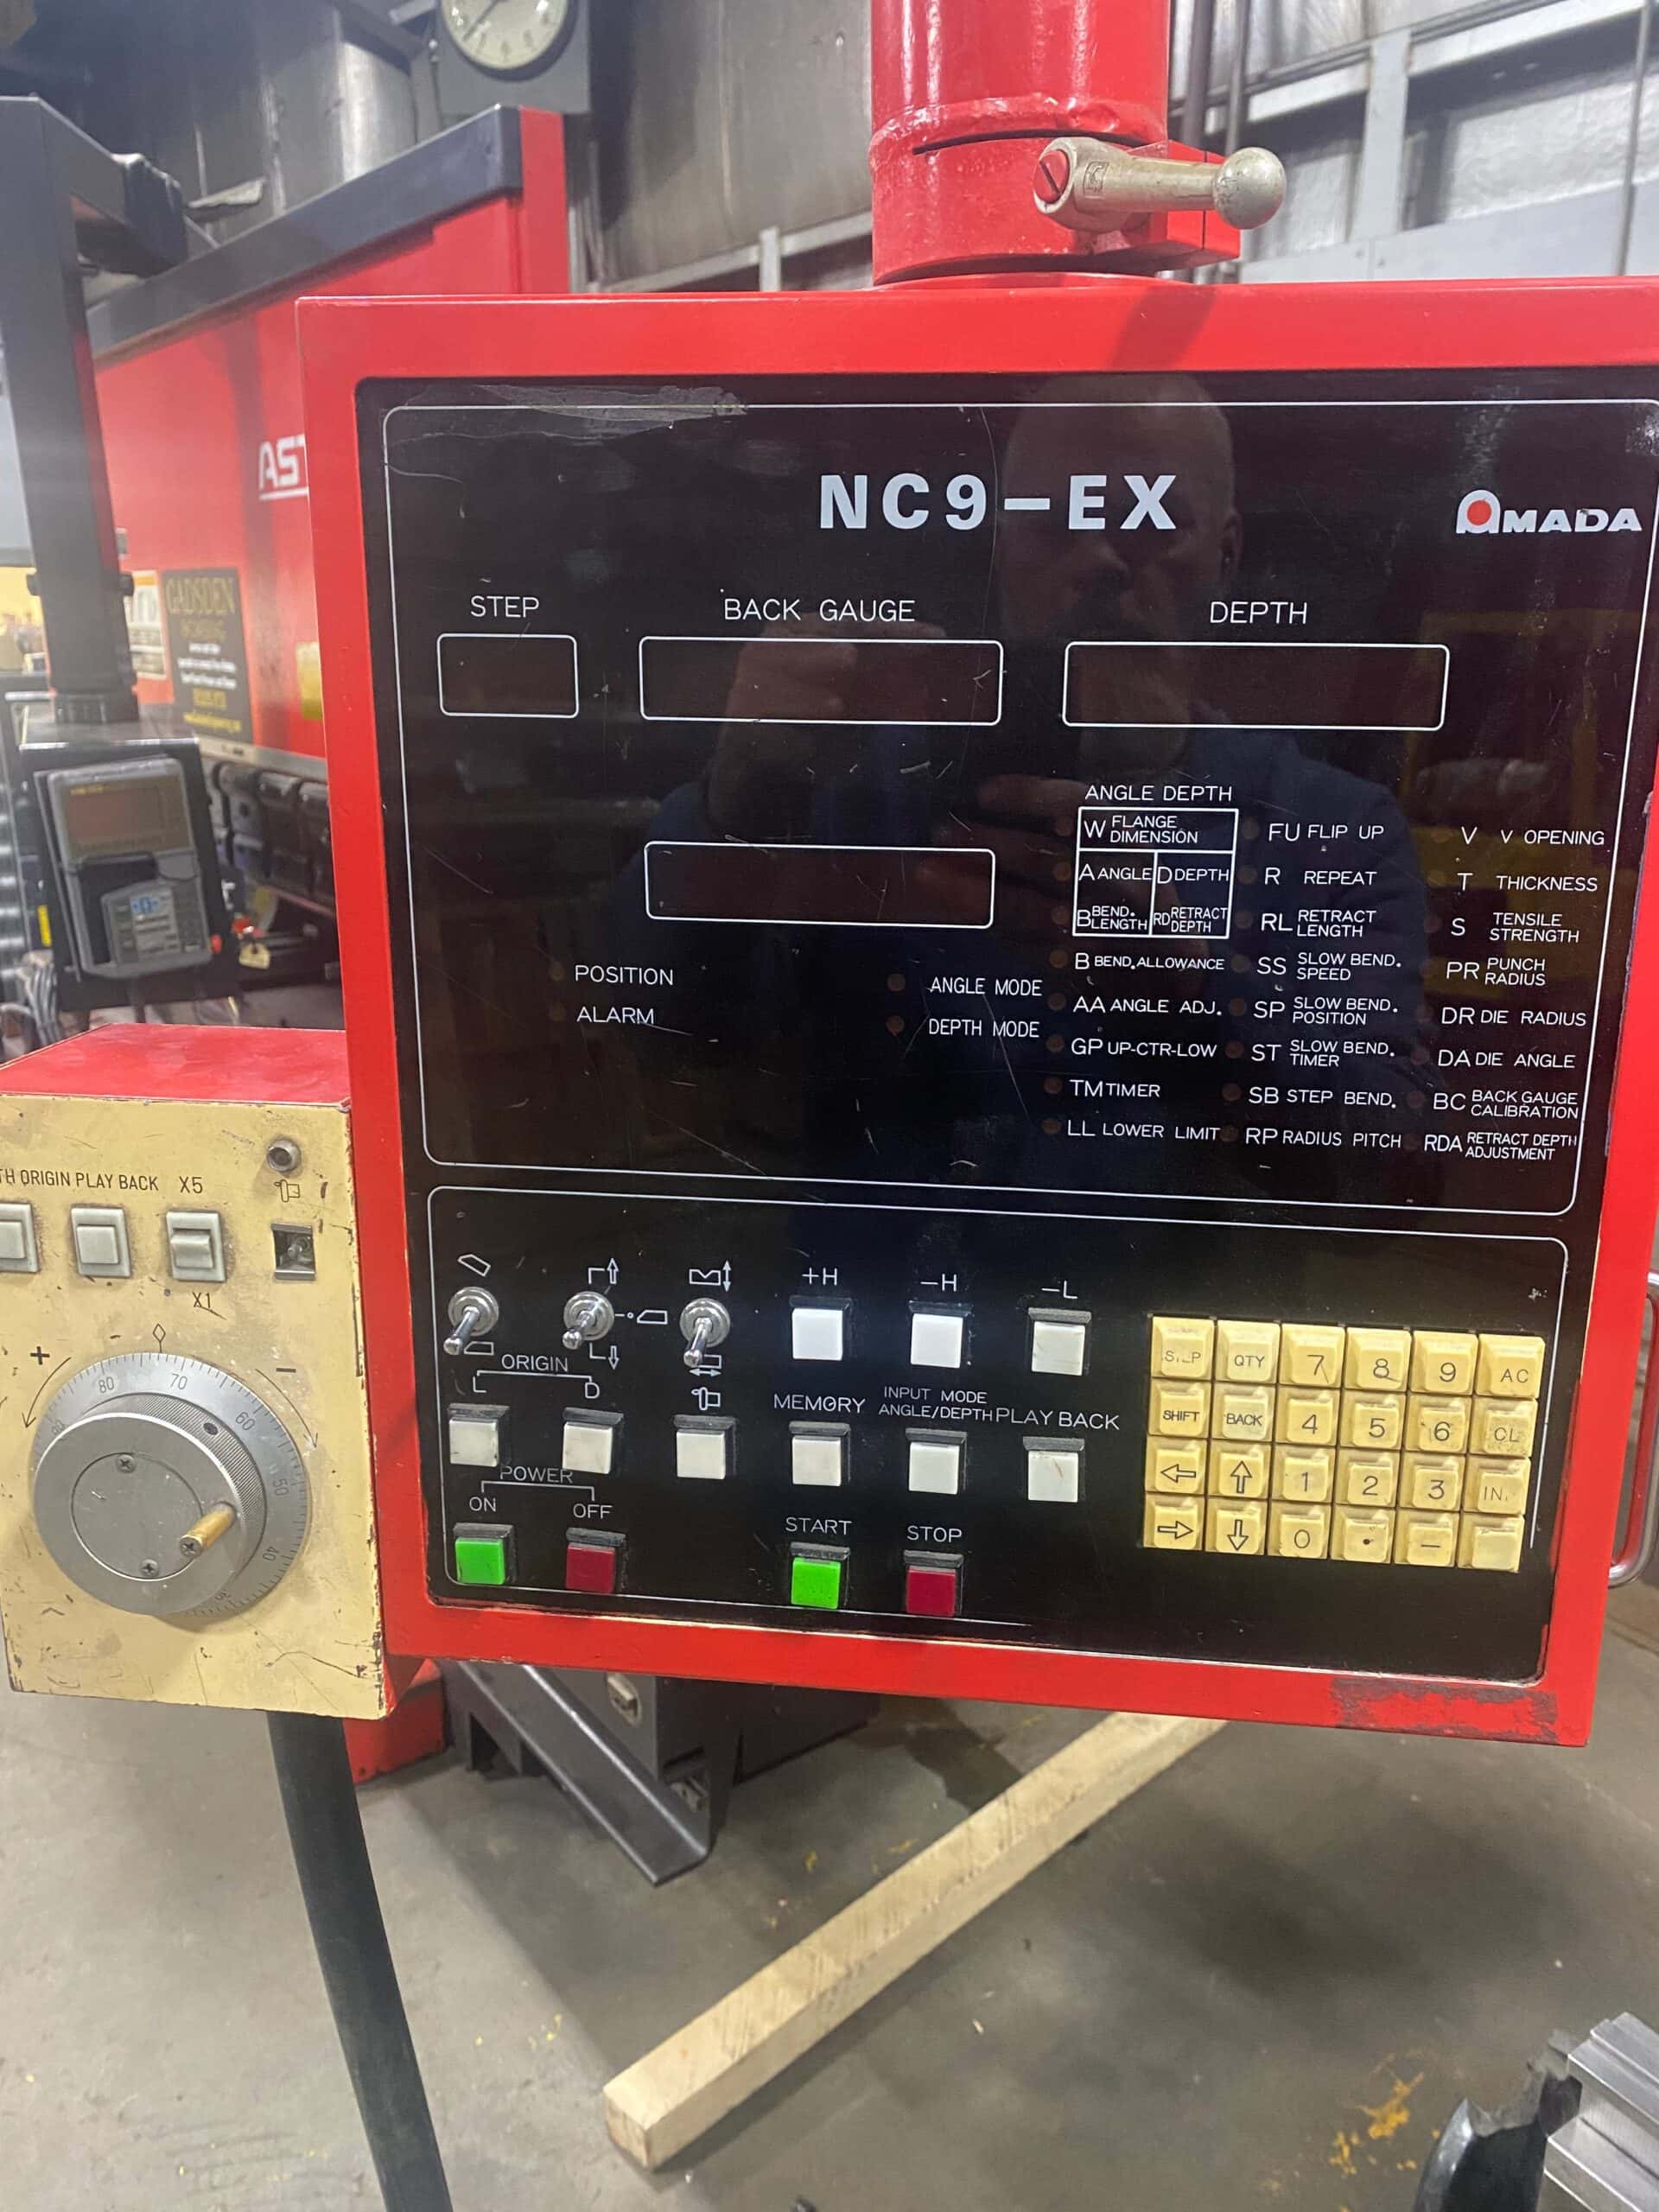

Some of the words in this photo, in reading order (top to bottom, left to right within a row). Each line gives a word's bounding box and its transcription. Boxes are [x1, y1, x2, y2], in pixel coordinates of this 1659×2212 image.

[1456, 489, 1642, 534] AMADA
[470, 595, 540, 619] STEP
[723, 598, 802, 622] BACK
[819, 598, 916, 623] GAUGE
[1210, 601, 1307, 625] DEPTH
[1085, 785, 1154, 801] ANGLE
[1163, 785, 1232, 802] DEPTH
[1084, 820, 1106, 838] W
[1112, 815, 1178, 829] FLANGE
[1110, 830, 1198, 844] DIMENSION
[1268, 823, 1300, 842] FU
[1307, 824, 1348, 839] FLIP
[1358, 825, 1384, 840] UP
[1461, 826, 1478, 844] V
[1524, 830, 1605, 845] OPENING
[1078, 864, 1095, 880] A
[1097, 867, 1153, 880] ANGLE
[1158, 867, 1173, 884] D
[1174, 868, 1230, 881] DEPTH
[1265, 867, 1281, 885] R
[1304, 870, 1377, 885] REPEAT
[1457, 873, 1473, 891] T
[1496, 875, 1598, 892] THICKNESS
[1092, 906, 1135, 917] BEND.
[1154, 912, 1171, 926] RD
[1171, 906, 1228, 919] RETRACT
[1298, 909, 1376, 923] RETRACT
[1492, 912, 1563, 926] TENSILE
[1091, 918, 1147, 931] LENGTH
[1171, 920, 1211, 932] DEPTH
[1261, 912, 1294, 931] RL
[1451, 918, 1465, 936] S
[1296, 925, 1363, 938] LENGTH
[1489, 928, 1580, 943] STRENGTH
[1075, 952, 1090, 969] B
[1257, 957, 1287, 975] SS
[1297, 952, 1346, 965] SLOW
[1351, 953, 1402, 968] BEND.
[1487, 957, 1546, 971] PUNCH
[574, 964, 673, 986] POSITION
[1296, 968, 1351, 981] SPEED
[1446, 962, 1479, 980] PR
[1484, 972, 1546, 986] RADIUS
[930, 976, 985, 995] ANGLE
[995, 978, 1042, 996] MODE
[1073, 996, 1106, 1014] AA
[1110, 999, 1169, 1013] ANGLE
[1179, 1001, 1222, 1016] ADJ.
[1253, 1001, 1286, 1019] SP
[1293, 996, 1342, 1009] SLOW
[1346, 998, 1398, 1013] BEND.
[576, 1006, 655, 1024] ALARM
[1292, 1011, 1367, 1026] POSITION
[1441, 1007, 1475, 1025] DR
[1480, 1009, 1509, 1024] DIE
[1521, 1011, 1586, 1027] RADIUS
[928, 1018, 982, 1036] DEPTH
[993, 1020, 1039, 1038] MODE
[1071, 1038, 1103, 1055] GP
[1251, 1044, 1281, 1062] ST
[1289, 1039, 1338, 1052] SLOW
[1343, 1041, 1395, 1057] BEND.
[1289, 1053, 1339, 1066] TIMER
[1438, 1050, 1471, 1068] DA
[1475, 1052, 1503, 1066] DIE
[1513, 1053, 1576, 1069] ANGLE
[1069, 1079, 1103, 1097] TM
[1105, 1083, 1160, 1097] TIMER
[1471, 1090, 1517, 1103] BACK
[1521, 1091, 1579, 1104] GAUGE
[1249, 1086, 1279, 1104] SB
[1287, 1089, 1333, 1103] STEP
[1344, 1091, 1396, 1109] BEND.
[1433, 1092, 1466, 1110] BC
[1471, 1104, 1579, 1119] CALIBRATION
[1068, 1120, 1096, 1136] LL
[1103, 1122, 1165, 1138] LOWER
[1175, 1127, 1220, 1141] LIMIT
[1245, 1128, 1278, 1145] RP
[1282, 1130, 1342, 1146] RADIUS
[1353, 1132, 1402, 1148] PITCH
[1466, 1132, 1529, 1146] RETRACT
[1533, 1134, 1577, 1147] DEPTH
[1424, 1135, 1463, 1153] RDA
[1465, 1146, 1555, 1160] ADJUSTMENT
[20, 1169, 71, 1187] ORIGIN
[76, 1173, 113, 1189] PLAY
[118, 1174, 159, 1192] BACK
[179, 1176, 203, 1194] X5
[802, 1267, 838, 1286] +H
[193, 1292, 213, 1308] X1
[501, 1354, 569, 1372] ORIGIN
[1234, 1354, 1266, 1370] QTY
[1306, 1354, 1325, 1376] 7
[1372, 1357, 1390, 1379] 8
[1440, 1362, 1457, 1382] 9
[1499, 1368, 1529, 1384] AC
[99, 1376, 115, 1394] 80
[171, 1373, 188, 1391] 70
[474, 1376, 486, 1393] L
[585, 1382, 601, 1399] D
[773, 1394, 866, 1413] MEMORY
[884, 1386, 931, 1402] INPUT
[941, 1389, 988, 1404] MODE
[235, 1411, 255, 1432] 60
[996, 1407, 1052, 1427] PLAY
[1058, 1412, 1120, 1431] BACK
[1162, 1409, 1200, 1424] SHIFT
[1226, 1413, 1263, 1427] BACK
[1301, 1414, 1319, 1434] 4
[1369, 1417, 1386, 1439] 5
[1434, 1421, 1450, 1442] 6
[1494, 1427, 1520, 1442] CL
[500, 1466, 573, 1484] POWER
[1300, 1471, 1308, 1492] 1
[272, 1478, 289, 1497] 50
[1362, 1475, 1379, 1496] 2
[1427, 1479, 1445, 1500] 3
[469, 1497, 497, 1512] ON
[573, 1503, 613, 1520] OFF
[785, 1517, 852, 1536] START
[907, 1525, 962, 1542] STOP
[1294, 1529, 1311, 1549] 0
[263, 1546, 280, 1561] 40
